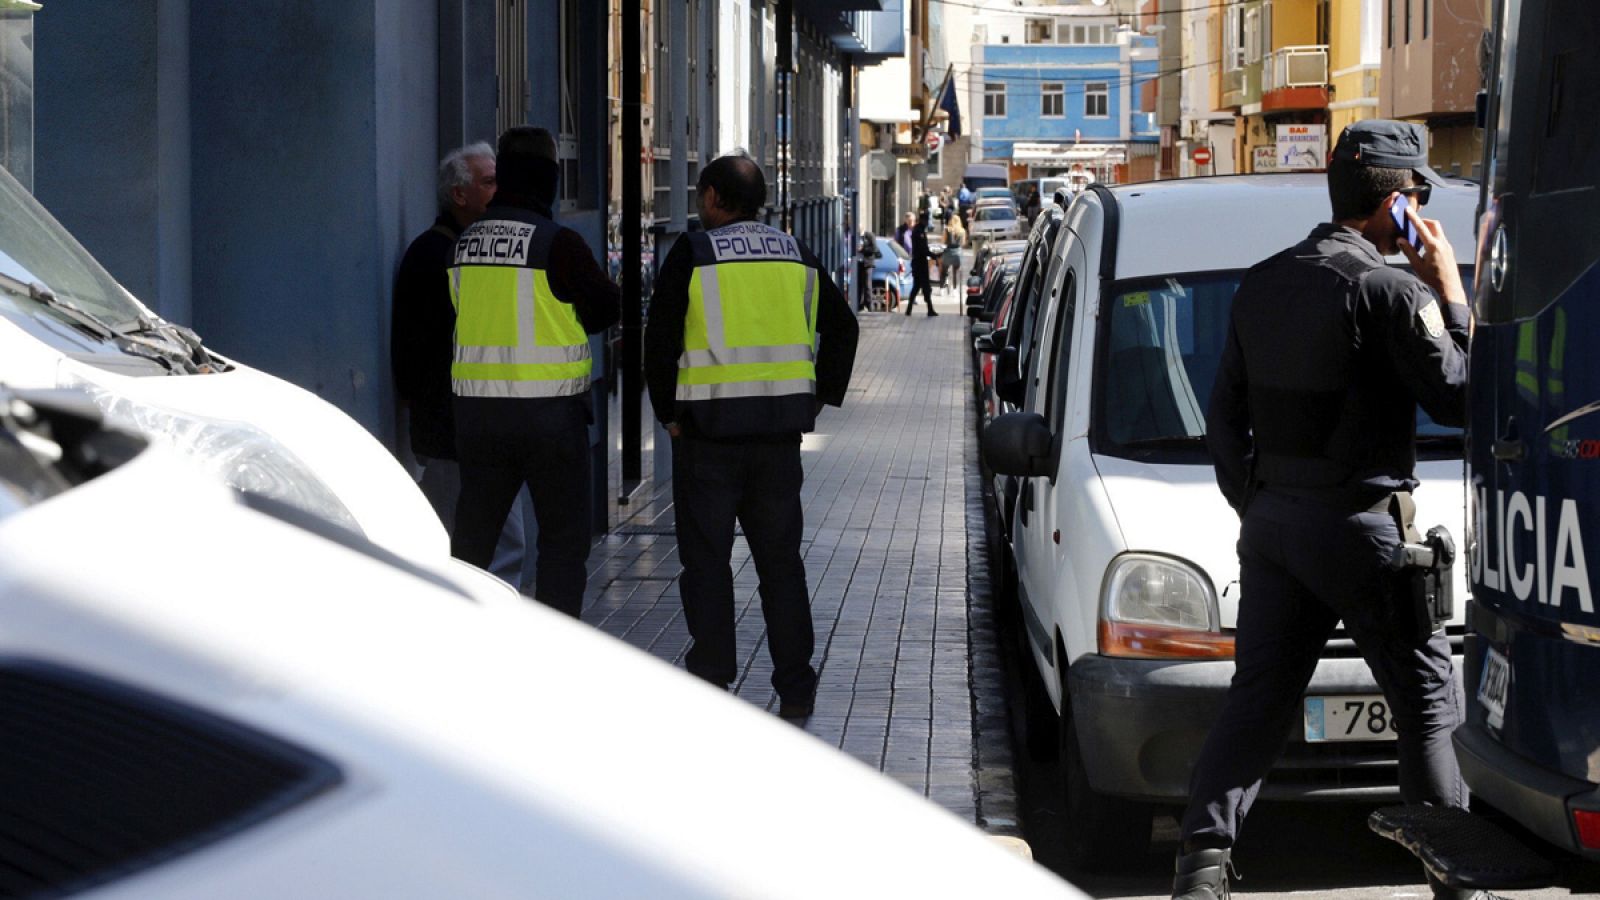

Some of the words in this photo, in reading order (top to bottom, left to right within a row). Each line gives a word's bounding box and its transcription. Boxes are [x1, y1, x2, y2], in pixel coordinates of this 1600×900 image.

[518, 227, 531, 237] DE
[457, 238, 524, 259] POLICIA
[716, 237, 798, 257] POLICIA
[1470, 481, 1594, 613] OLICIA
